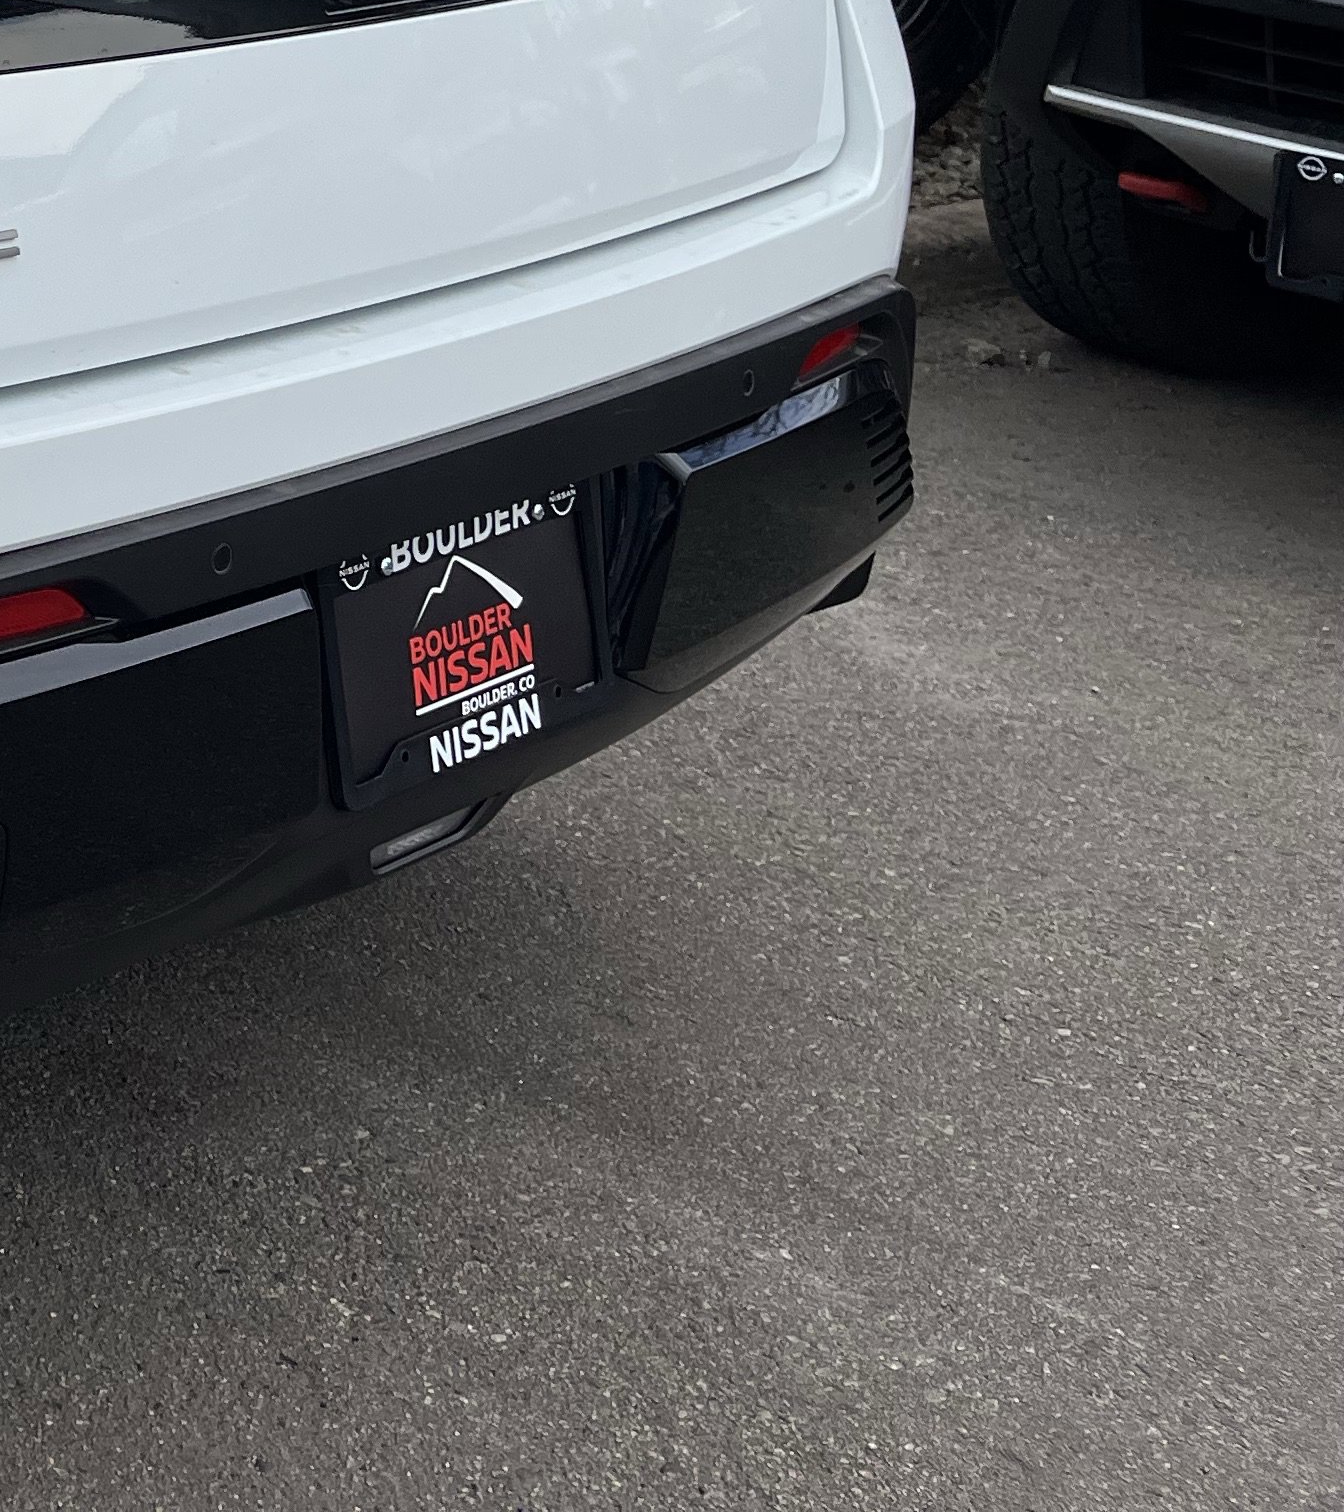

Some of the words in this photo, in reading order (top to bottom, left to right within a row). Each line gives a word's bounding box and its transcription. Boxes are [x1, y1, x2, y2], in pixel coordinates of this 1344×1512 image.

[390, 499, 531, 573] BOULDER
[409, 603, 512, 664] BOULDER
[412, 624, 534, 707] NISSAN
[518, 675, 535, 692] CO
[429, 693, 542, 774] NISSAN
